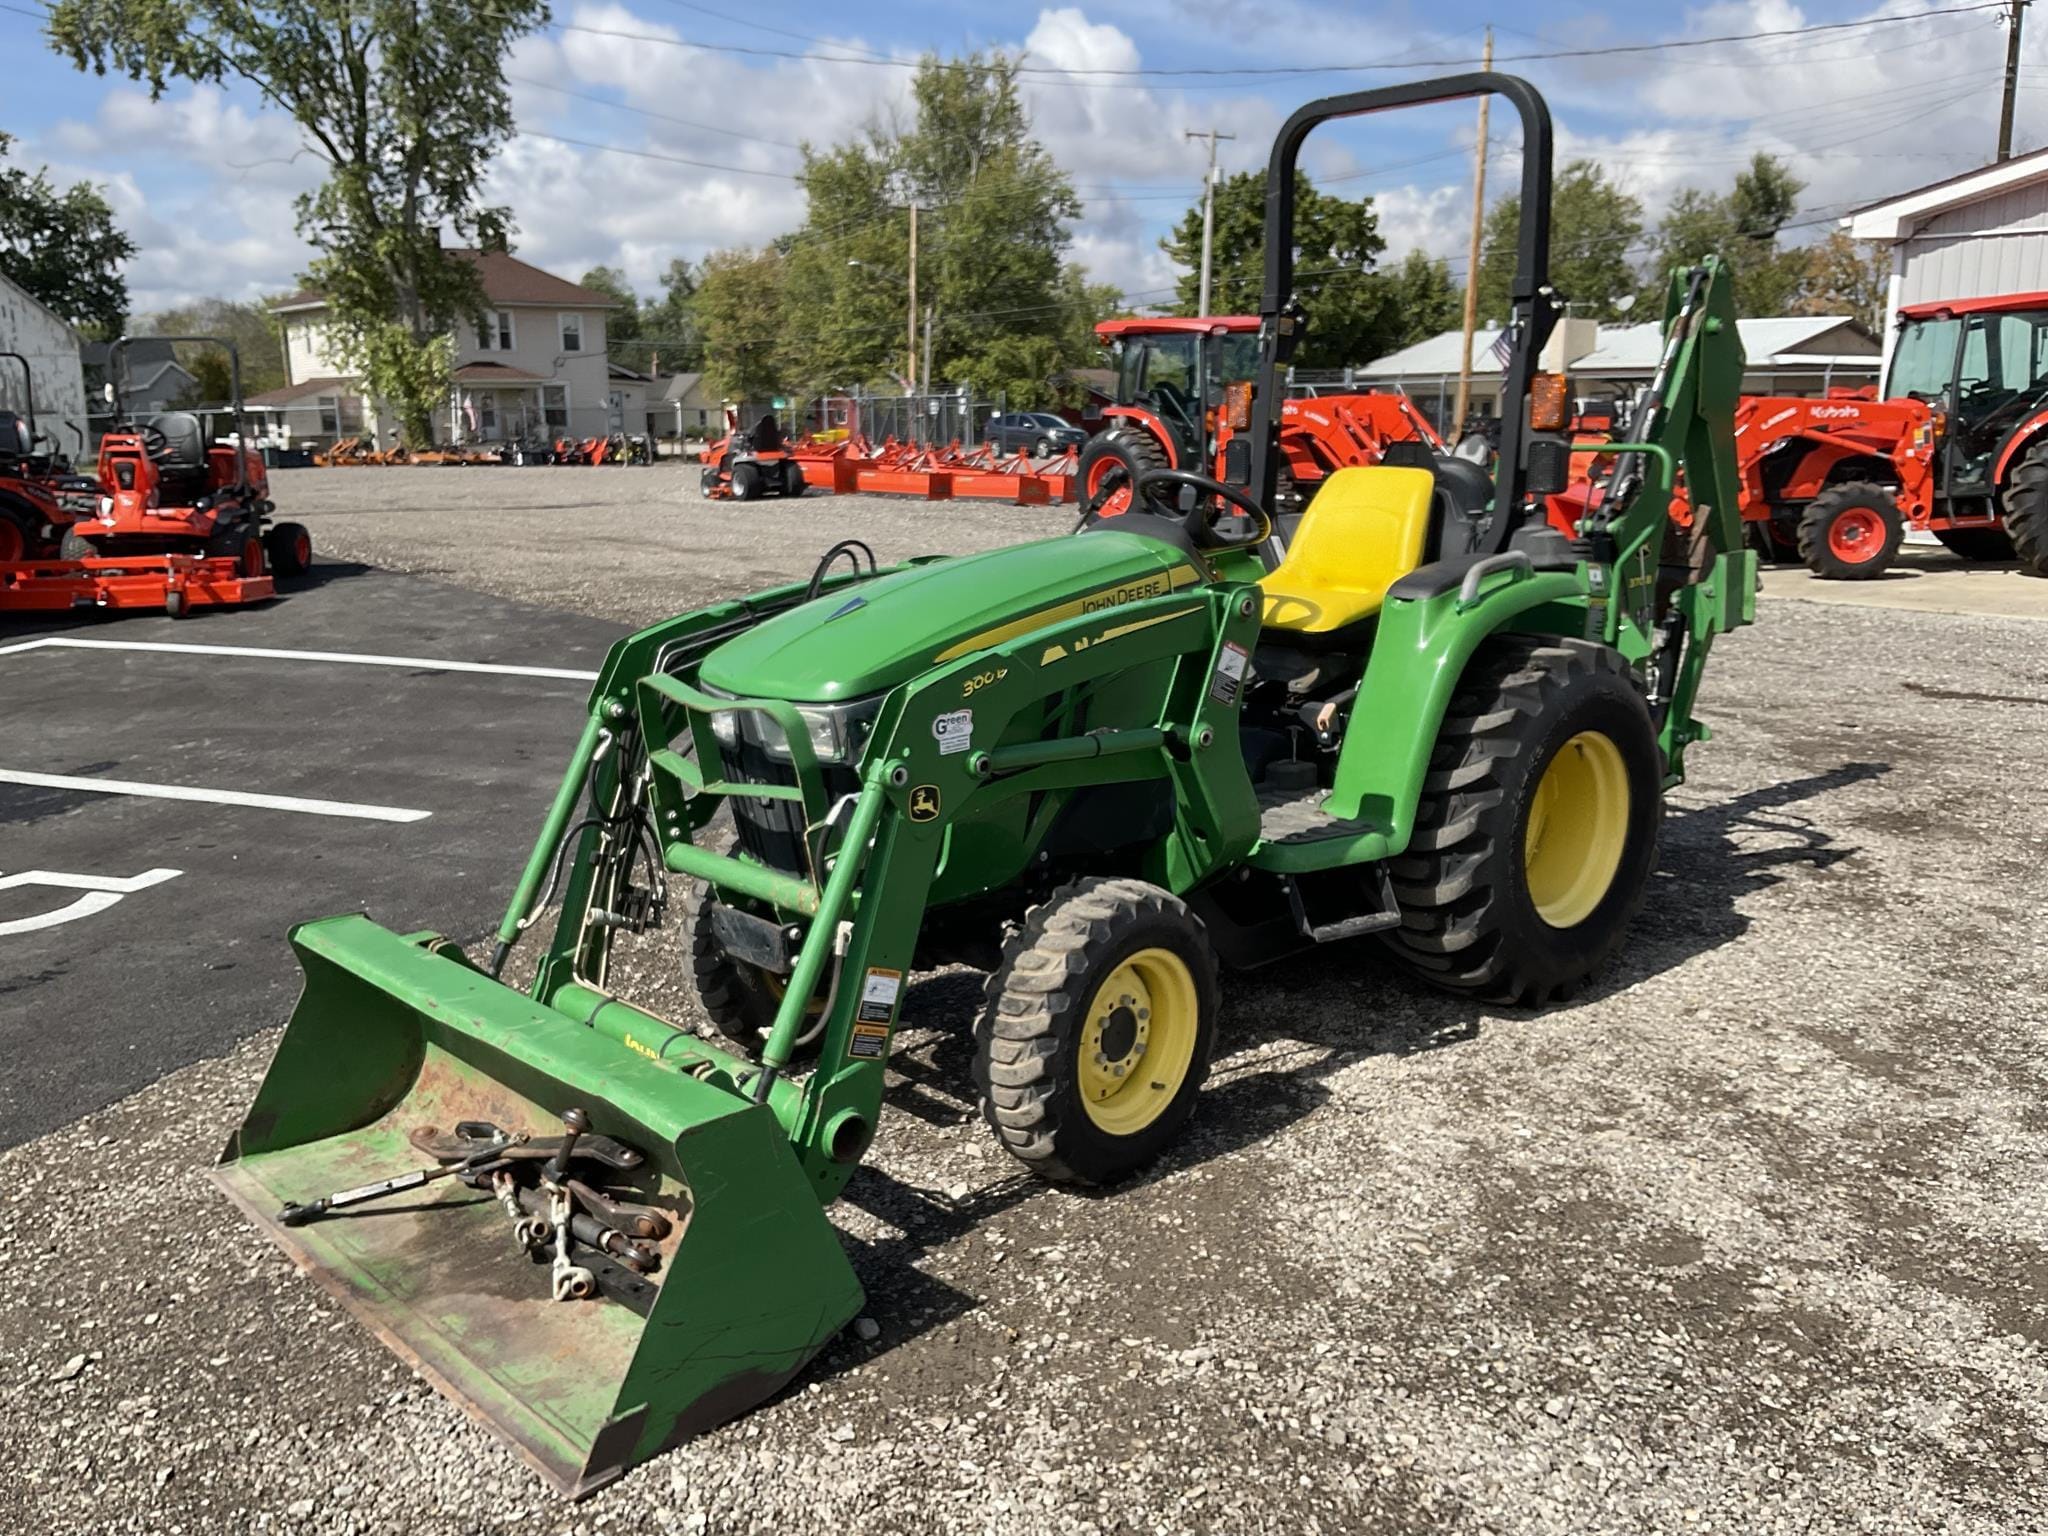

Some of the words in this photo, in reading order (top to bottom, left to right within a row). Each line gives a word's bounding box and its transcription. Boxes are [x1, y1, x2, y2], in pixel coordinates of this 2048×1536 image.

[1811, 404, 1860, 418] Kubota
[1082, 595, 1116, 615] JOHN
[1117, 580, 1160, 605] DEERE
[935, 714, 968, 735] Green
